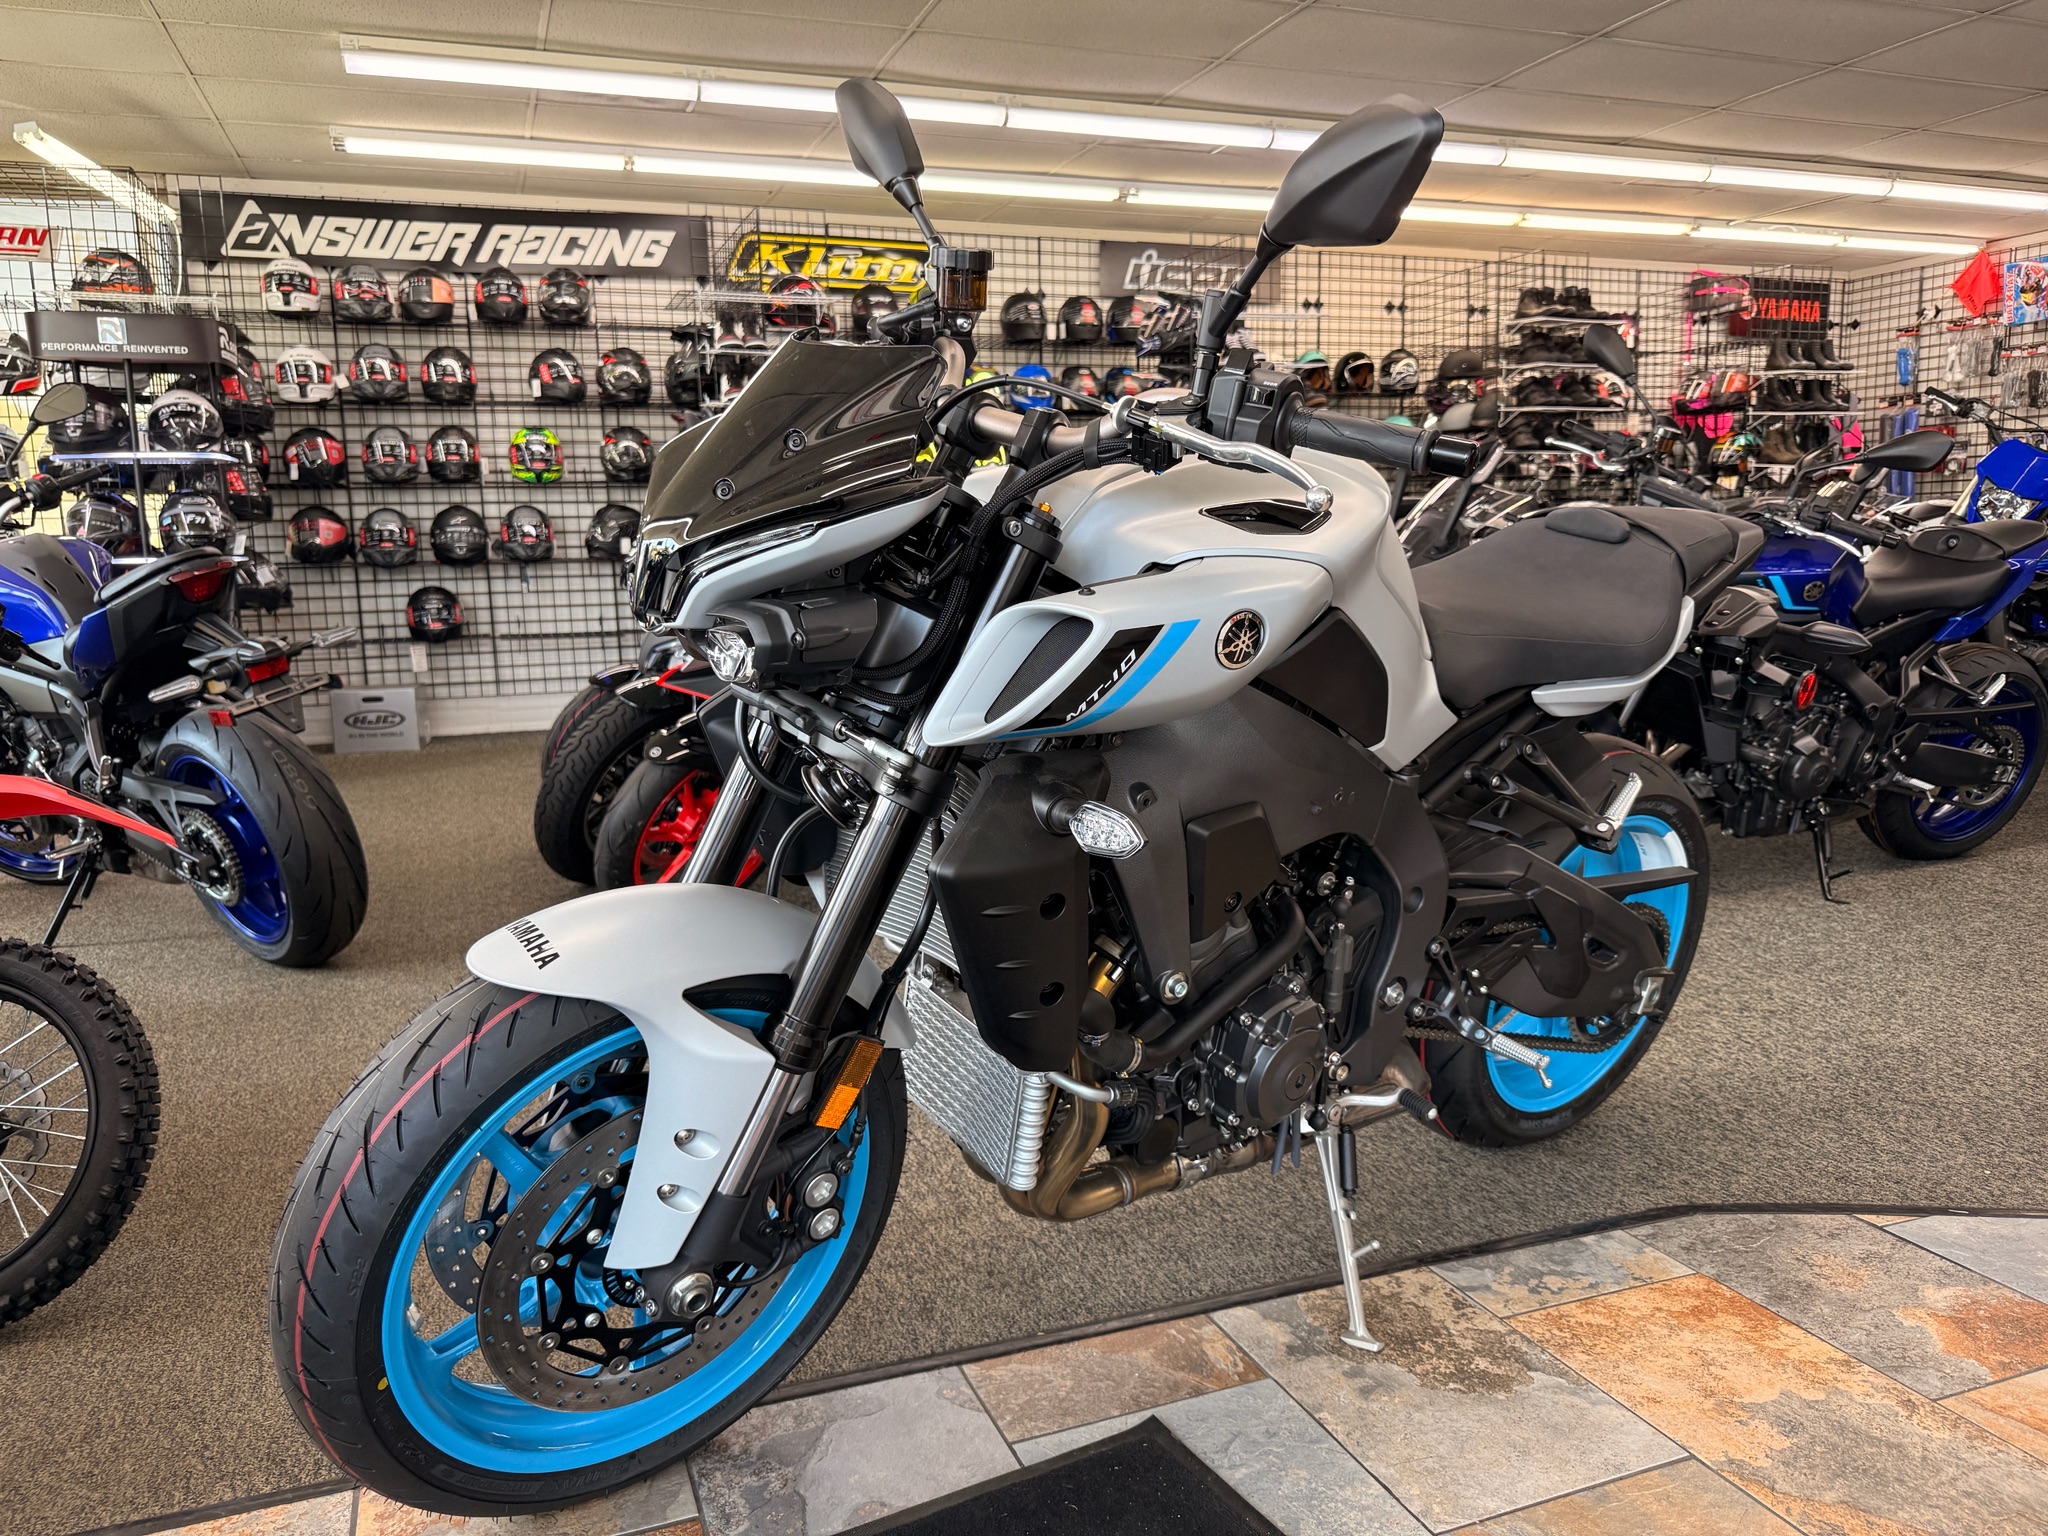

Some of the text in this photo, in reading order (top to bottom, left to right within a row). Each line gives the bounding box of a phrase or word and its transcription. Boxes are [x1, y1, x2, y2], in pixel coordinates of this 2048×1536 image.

[221, 199, 677, 269] ANSWER RACING
[1759, 297, 1820, 323] YAMAHA
[41, 342, 189, 355] PERFORMANCE REINVENTED
[1066, 648, 1136, 722] MT-10
[352, 715, 397, 726] HJC
[504, 917, 560, 971] YAMAHA
